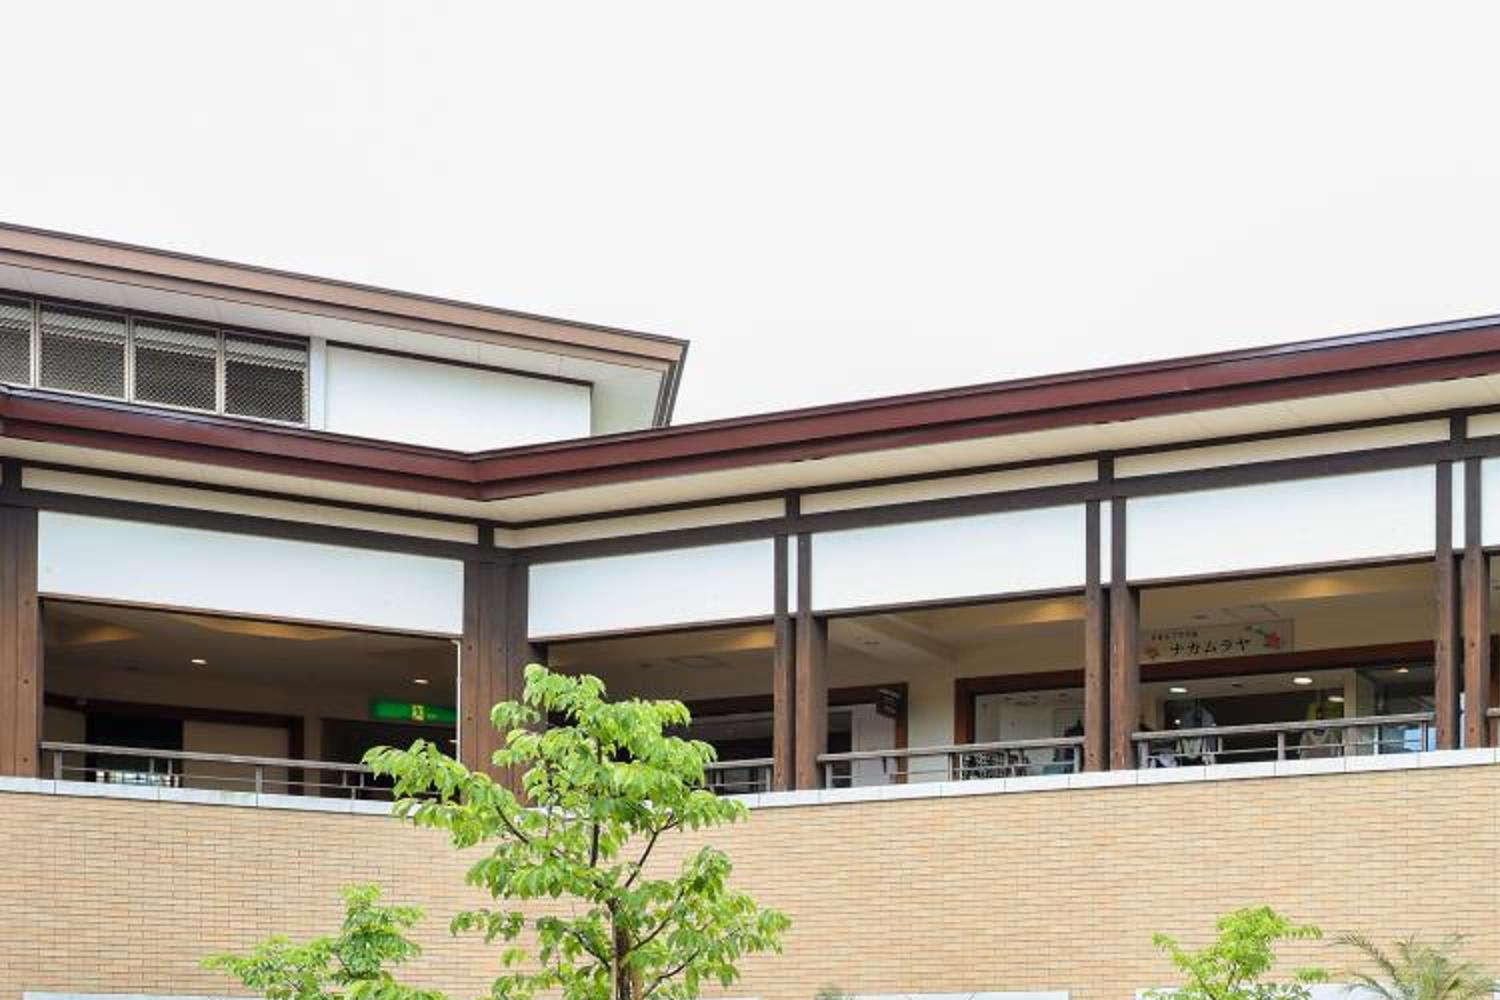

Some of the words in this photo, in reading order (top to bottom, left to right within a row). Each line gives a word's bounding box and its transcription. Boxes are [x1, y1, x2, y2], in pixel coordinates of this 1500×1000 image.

[1169, 636, 1251, 656] ナカムラヤ
